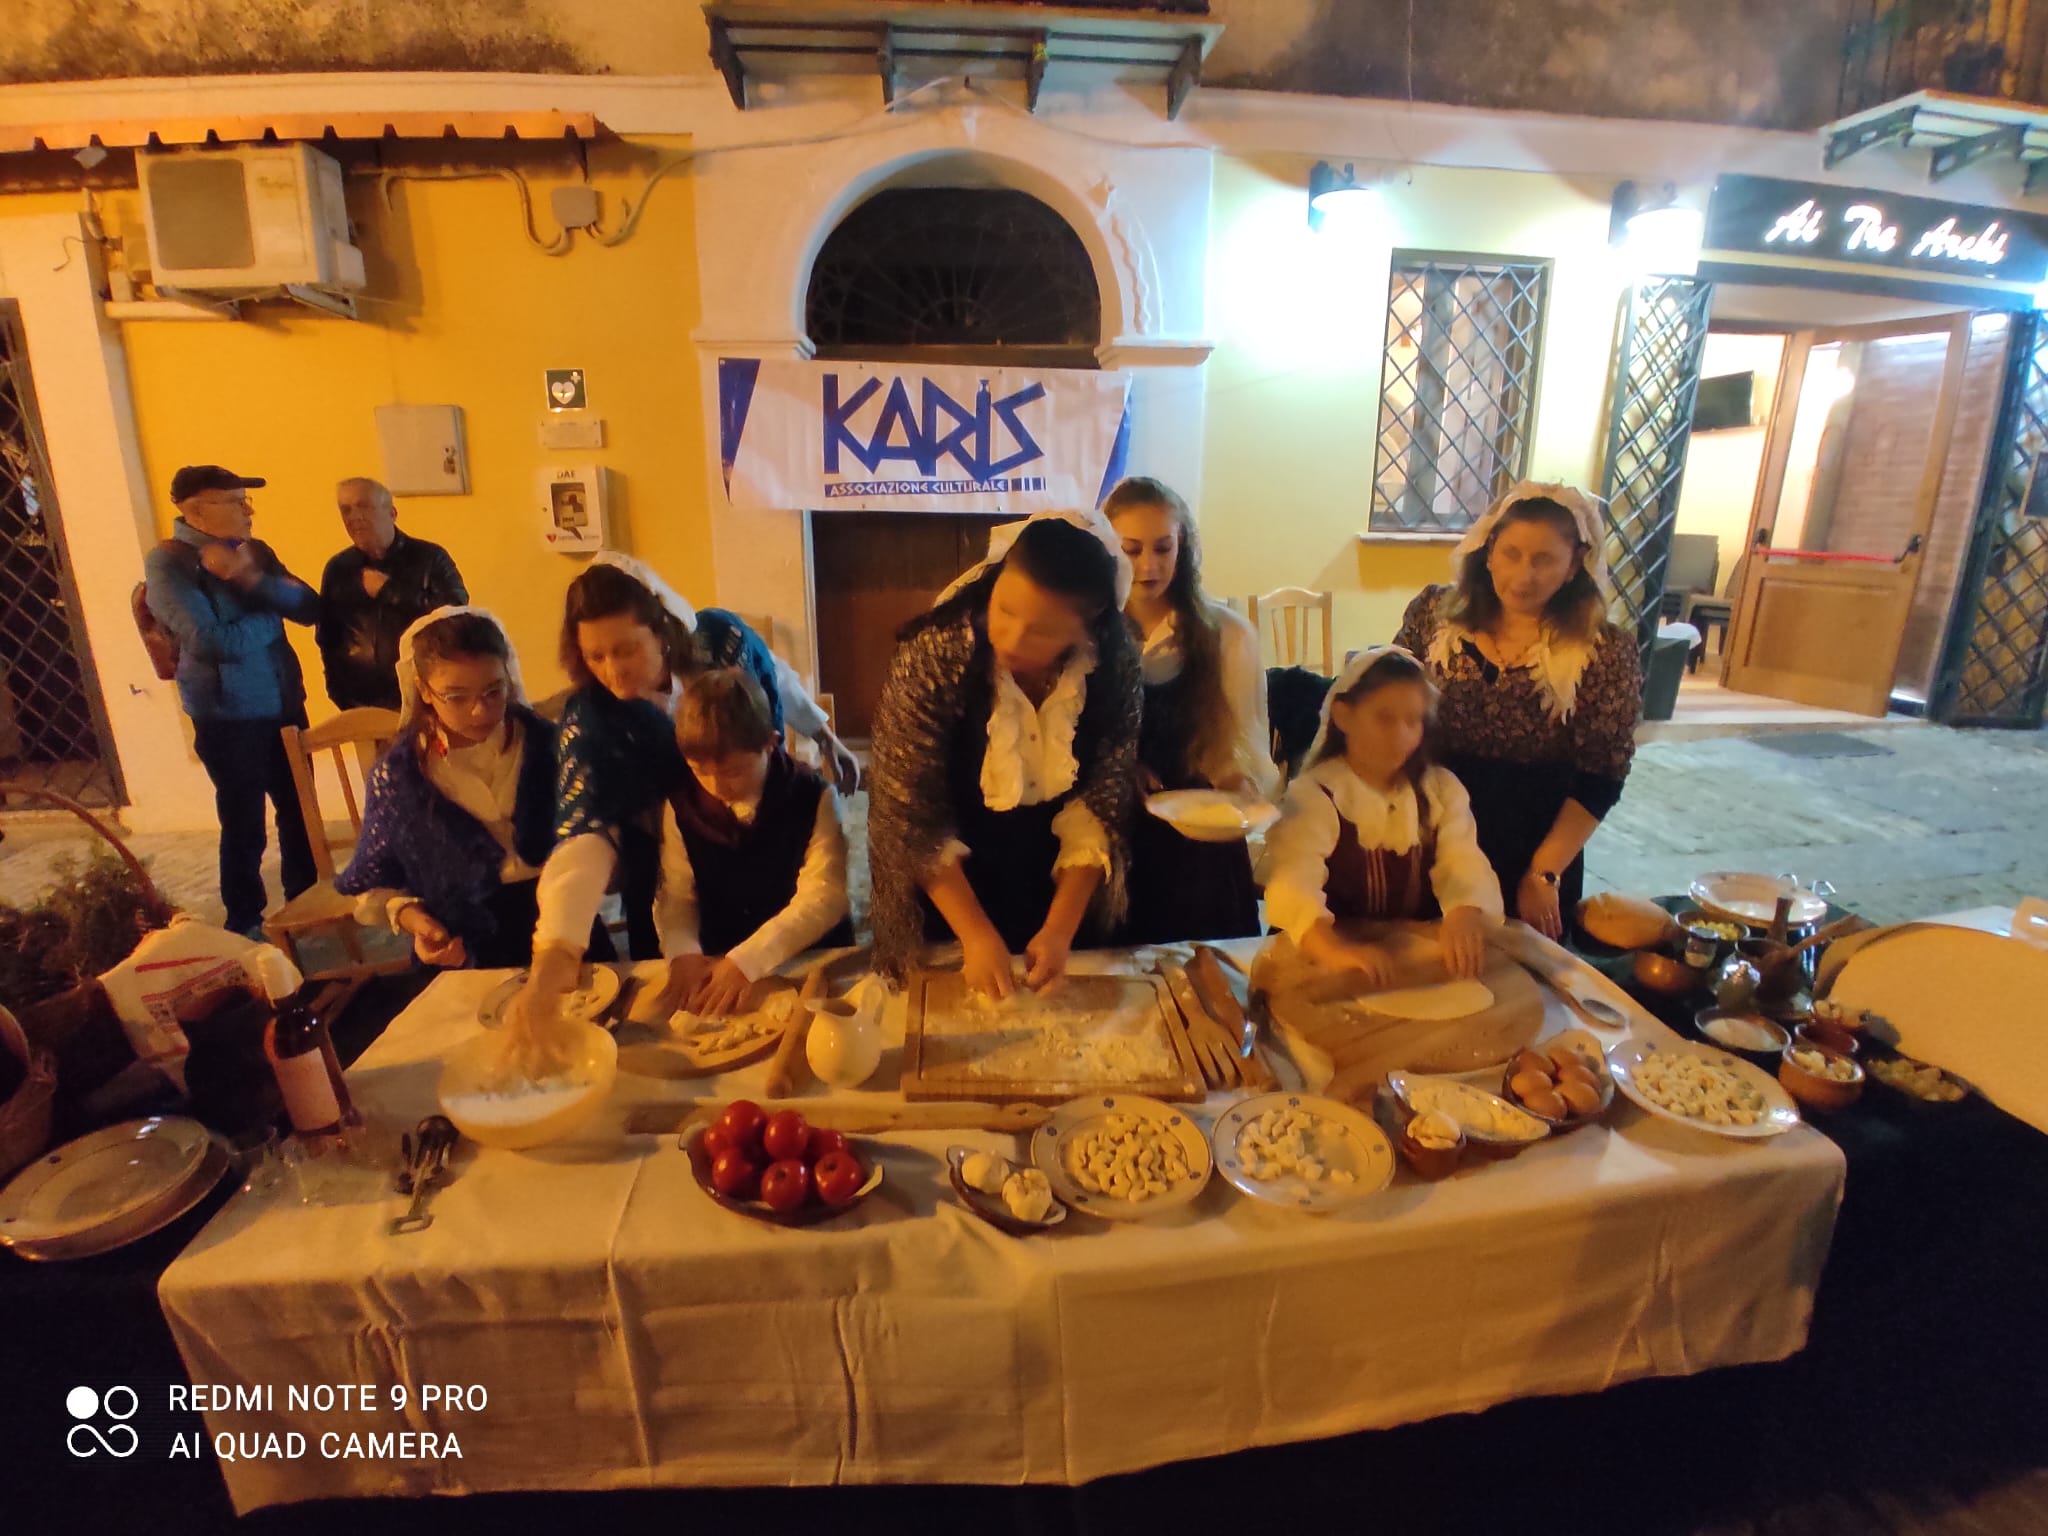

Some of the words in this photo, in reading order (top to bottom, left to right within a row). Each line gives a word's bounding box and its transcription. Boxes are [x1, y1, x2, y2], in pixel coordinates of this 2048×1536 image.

[822, 373, 1048, 482] KARIS
[829, 481, 930, 497] ASSOCIAZIONE
[932, 478, 1006, 495] CULTURALE
